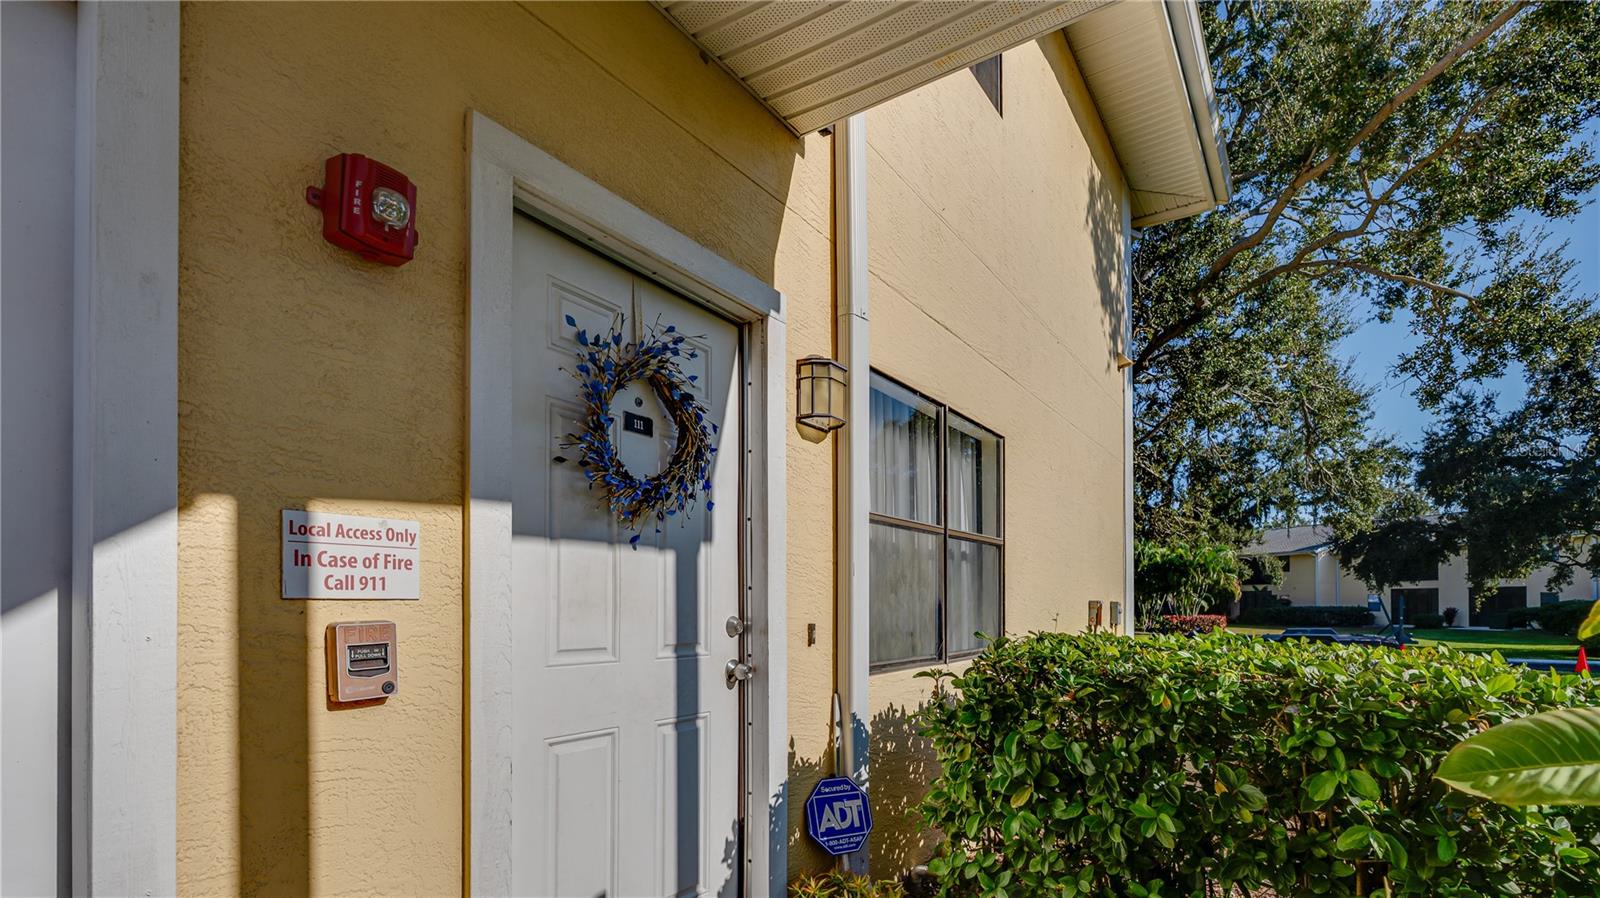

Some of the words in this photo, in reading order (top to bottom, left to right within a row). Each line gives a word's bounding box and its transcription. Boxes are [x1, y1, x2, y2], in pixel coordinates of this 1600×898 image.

[353, 180, 363, 215] FIRE
[633, 418, 644, 430] 111
[288, 519, 331, 538] Local
[335, 523, 382, 541] Access
[385, 527, 417, 546] Only
[293, 549, 312, 567] In
[317, 550, 358, 569] Case
[362, 553, 380, 570] of
[384, 553, 413, 571] Fire
[324, 574, 355, 591] Call
[360, 576, 386, 591] 911
[344, 625, 392, 643] FIRE
[820, 785, 844, 793] Secured
[843, 784, 851, 792] by
[820, 798, 862, 833] ADT
